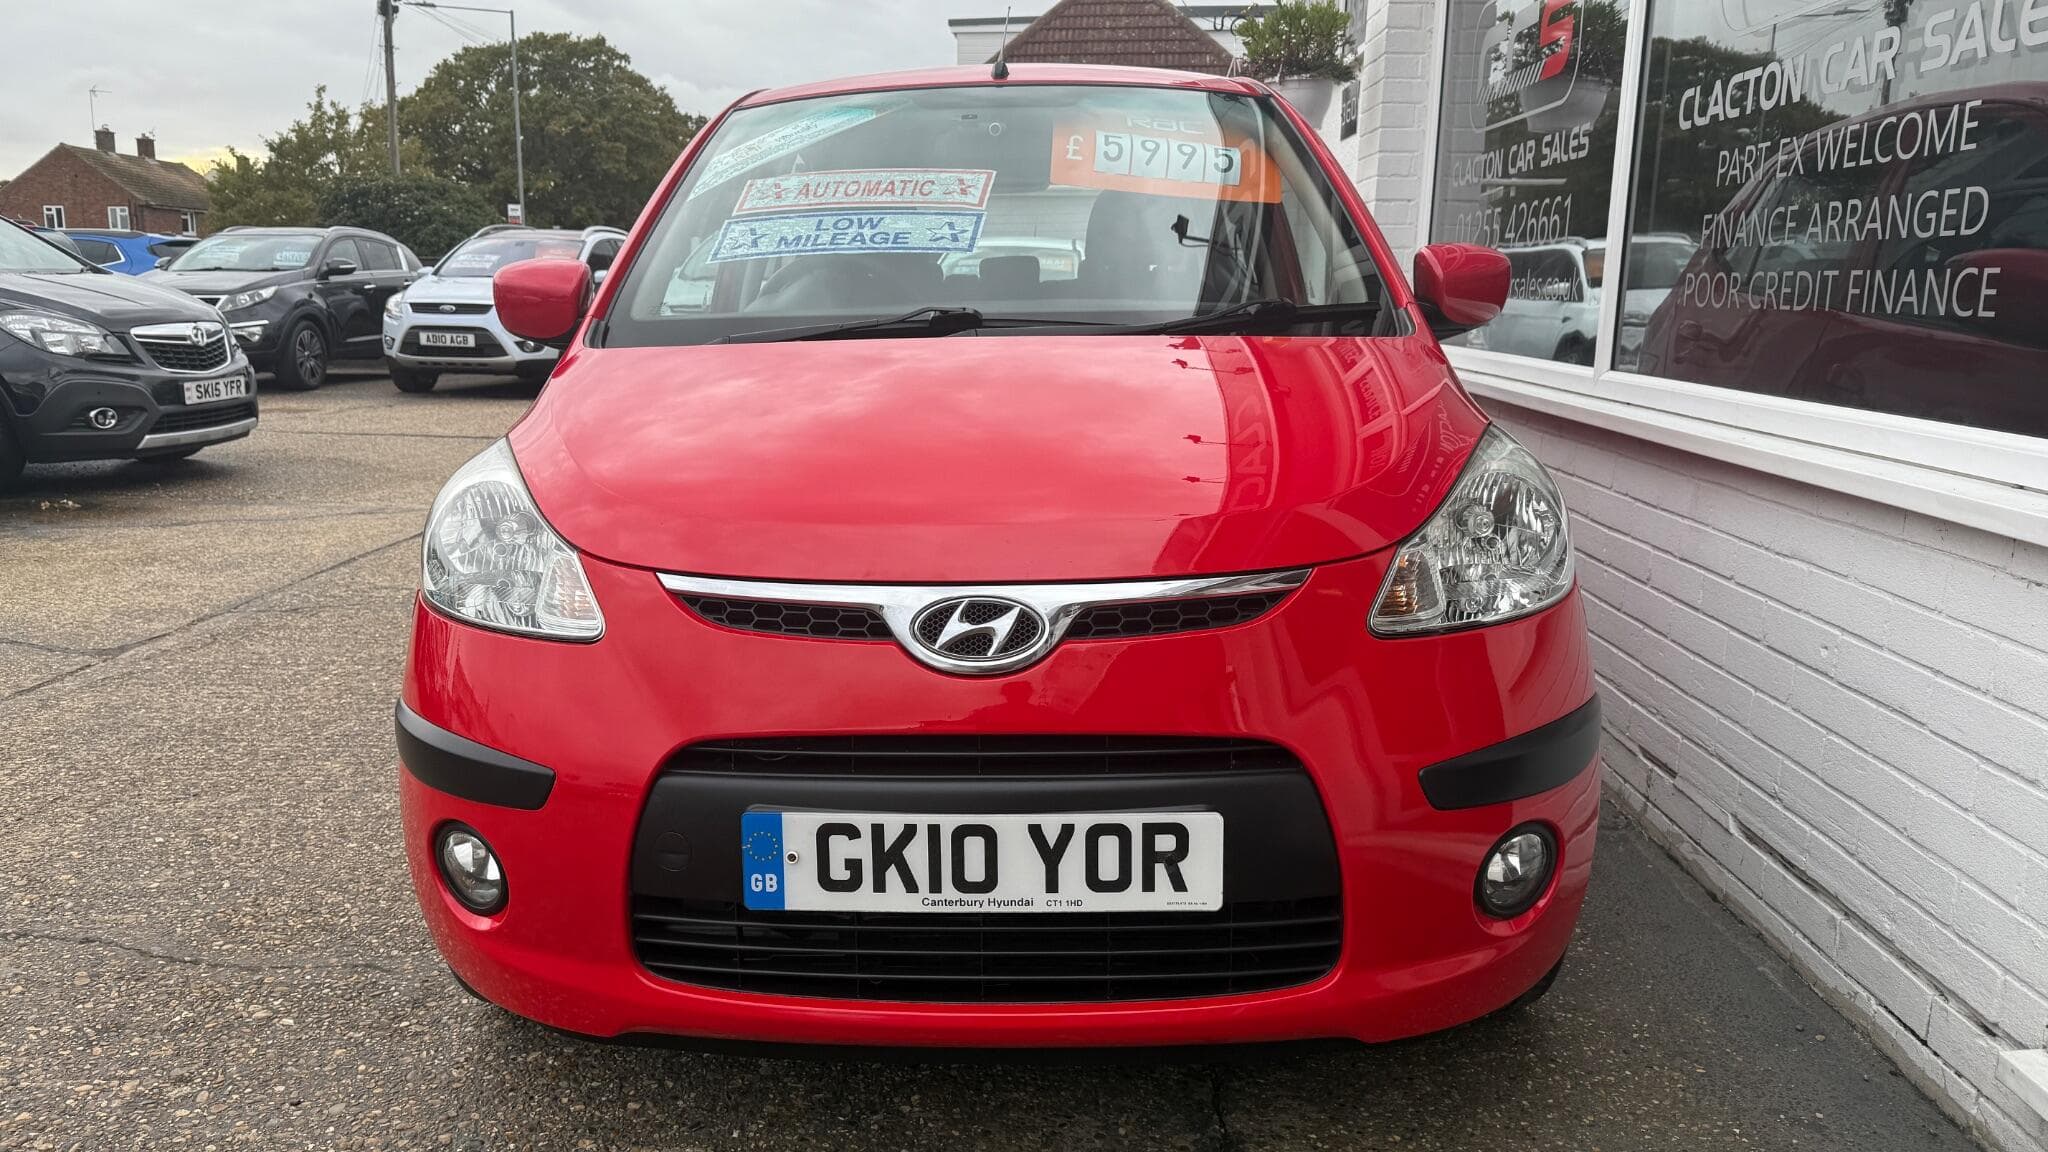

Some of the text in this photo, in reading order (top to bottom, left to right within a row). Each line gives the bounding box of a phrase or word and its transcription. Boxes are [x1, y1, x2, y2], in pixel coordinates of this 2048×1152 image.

[1679, 54, 1807, 131] CLACTON
[1821, 25, 1903, 95] CAR
[1452, 122, 1591, 188] CLACTON CAR SALES
[1716, 100, 1983, 187] PART EX WELCOME
[793, 179, 937, 200] AUTOMATIC
[815, 216, 886, 232] LOW
[1455, 193, 1573, 250] 01255 426661
[1700, 185, 1990, 250] FINANCE ARRANGED
[775, 231, 912, 249] MILEAGE
[1683, 266, 2001, 318] POOR CREDIT FINANCE
[426, 334, 469, 345] AD10 AGB
[195, 379, 242, 400] SK15 YFR
[815, 822, 1190, 894] GK10 YOR
[750, 873, 778, 893] GB
[921, 897, 1083, 909] Canterbury Hyundai CT1 1HD
